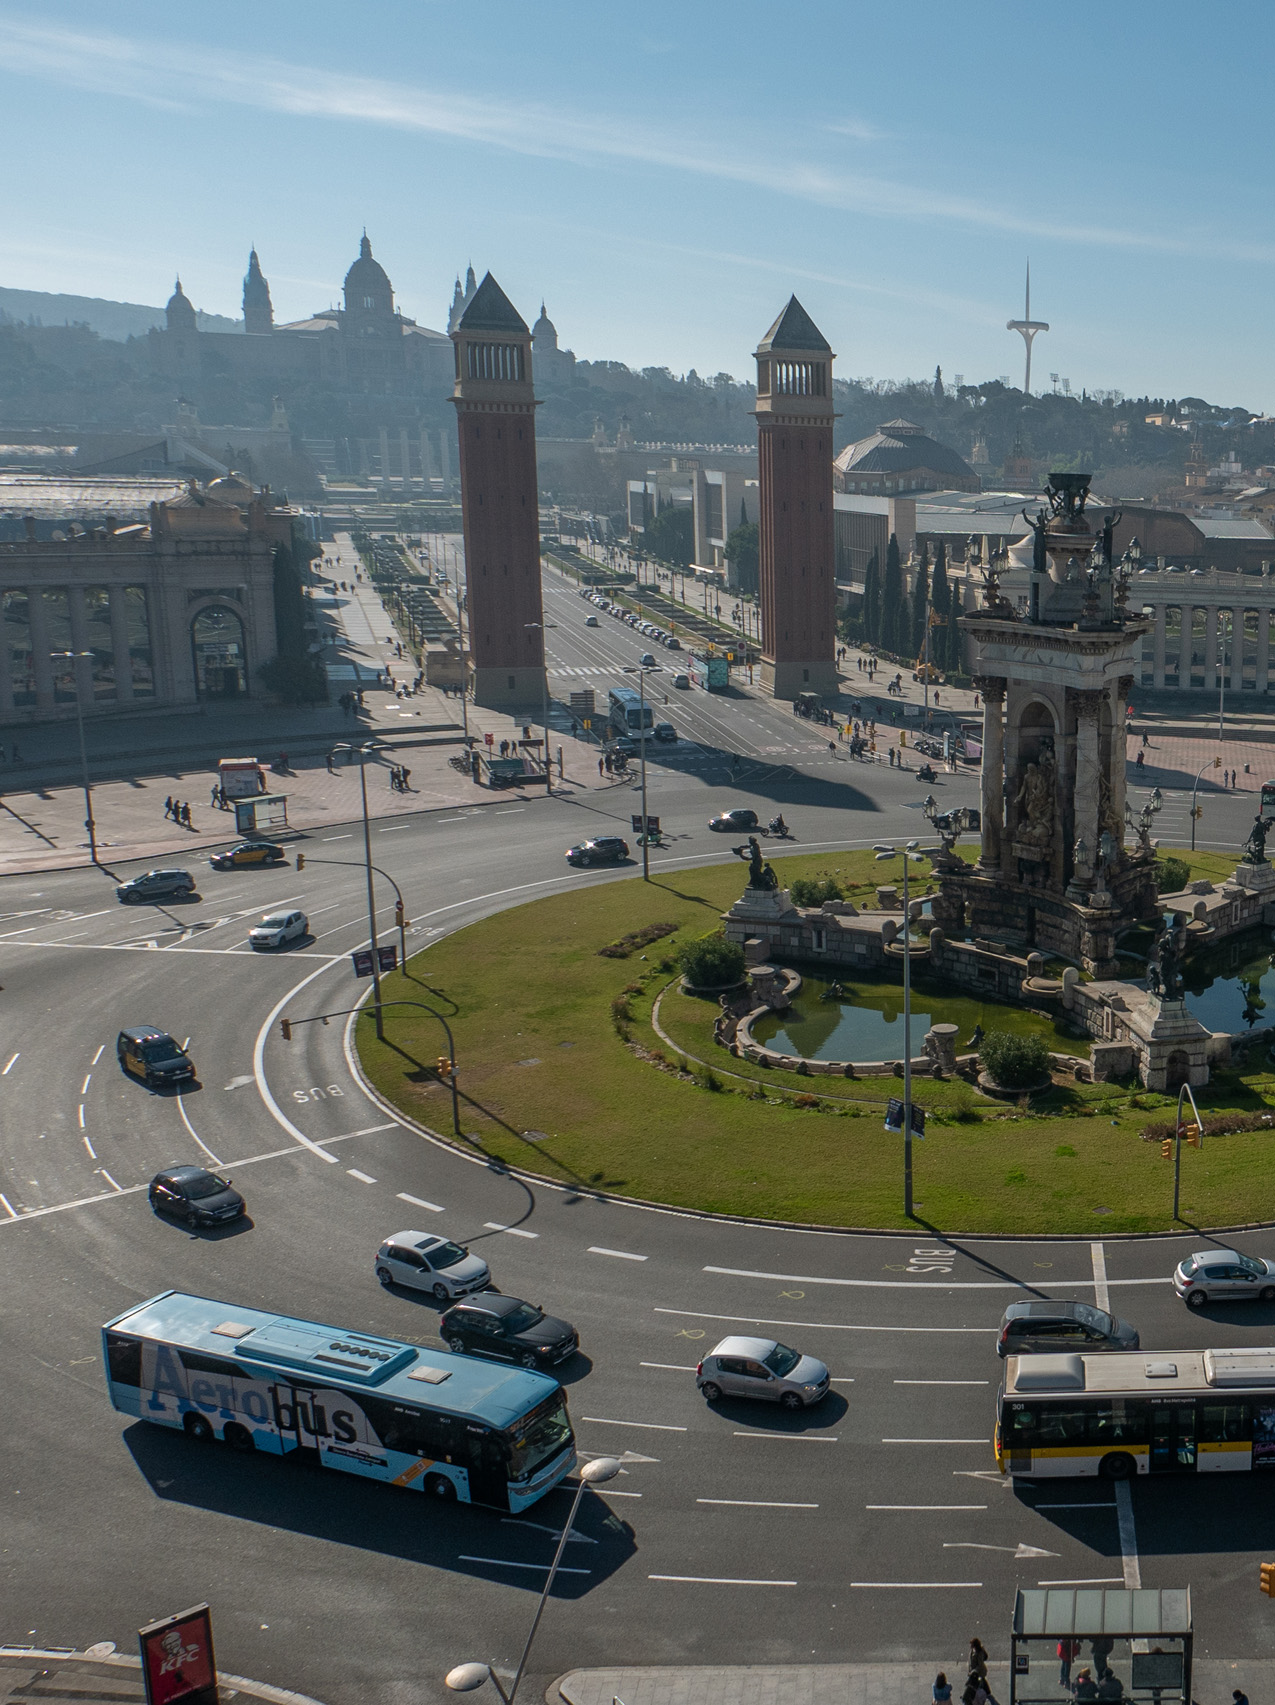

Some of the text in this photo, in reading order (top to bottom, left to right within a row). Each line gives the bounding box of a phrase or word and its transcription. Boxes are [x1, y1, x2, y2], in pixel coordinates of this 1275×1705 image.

[293, 1084, 344, 1103] BUS
[906, 1249, 957, 1273] BUS
[146, 1344, 357, 1444] Aerobus
[1012, 1403, 1025, 1411] 301
[159, 1648, 200, 1676] KFC
